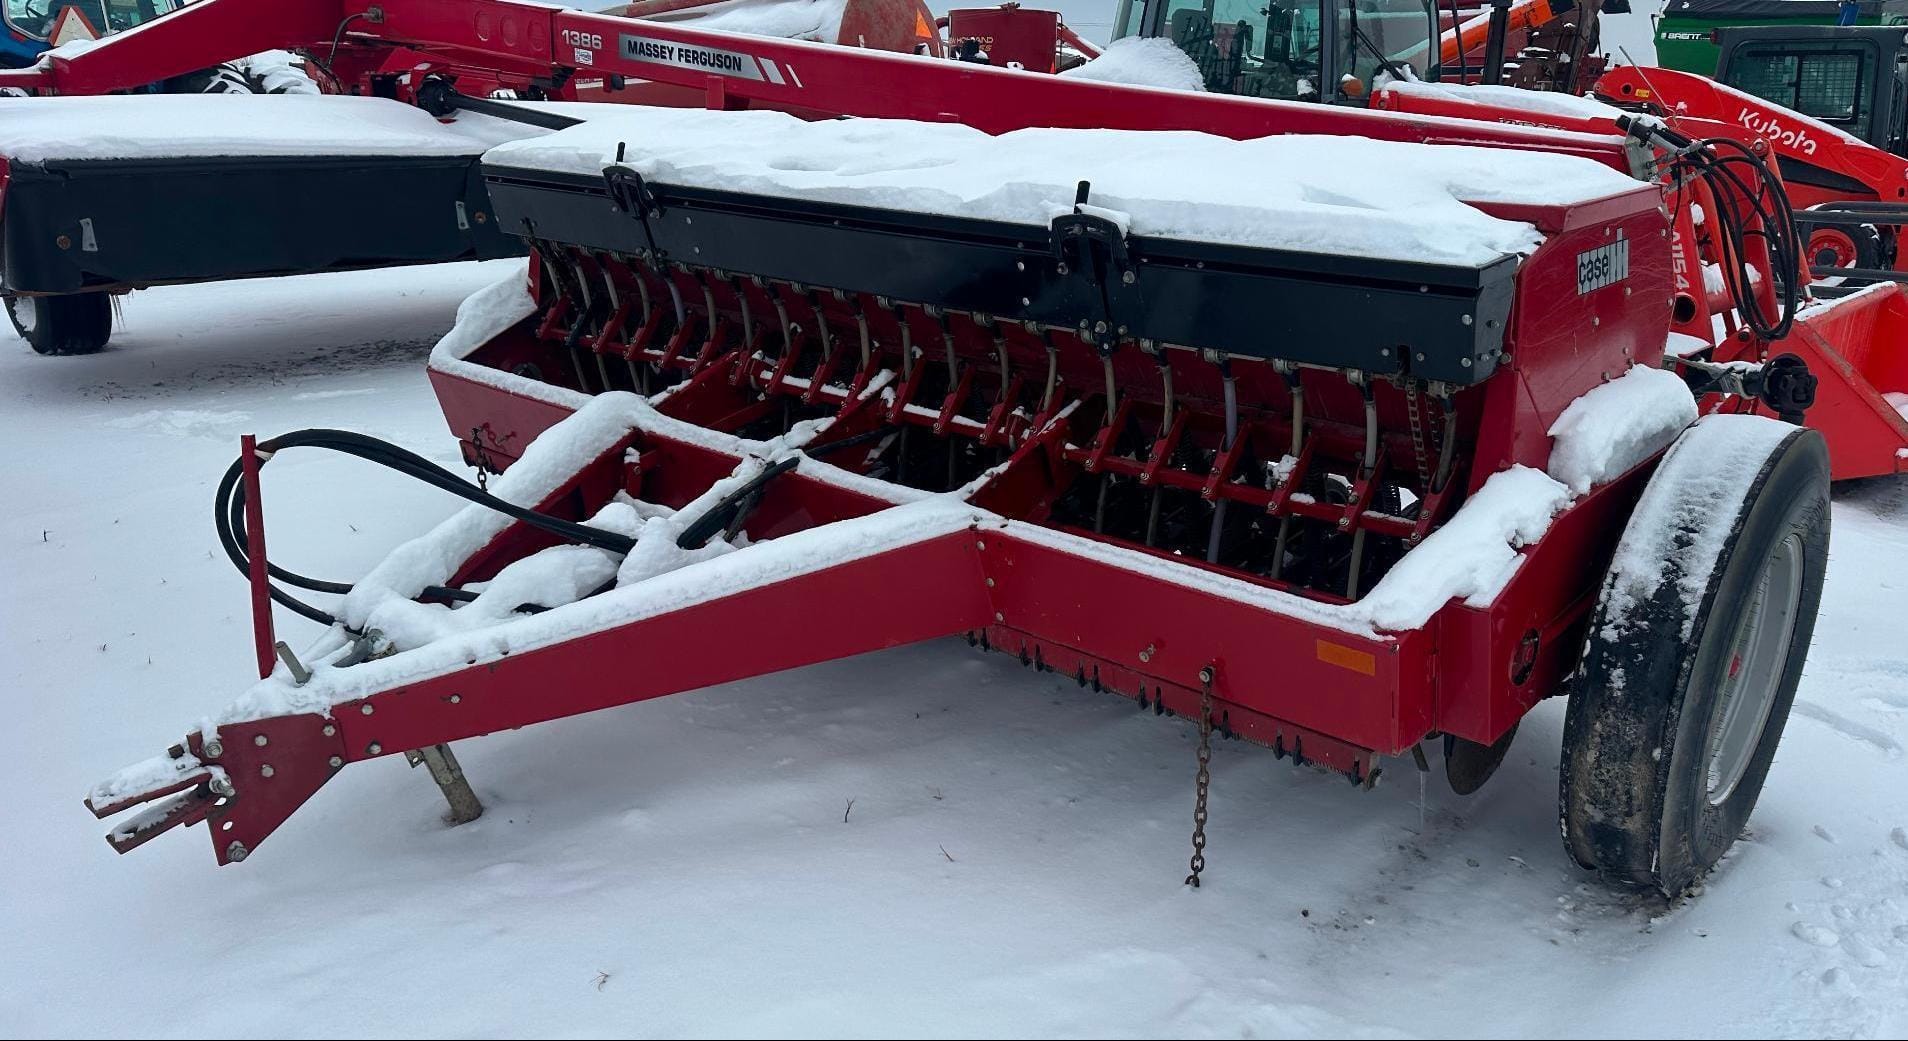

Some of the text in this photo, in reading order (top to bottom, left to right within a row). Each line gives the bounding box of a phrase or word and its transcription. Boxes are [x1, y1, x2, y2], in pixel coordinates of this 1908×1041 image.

[562, 29, 602, 49] 1386
[1668, 32, 1701, 40] BRENT
[627, 40, 742, 72] MASSEY FERGUSON
[1738, 107, 1817, 156] Kubota
